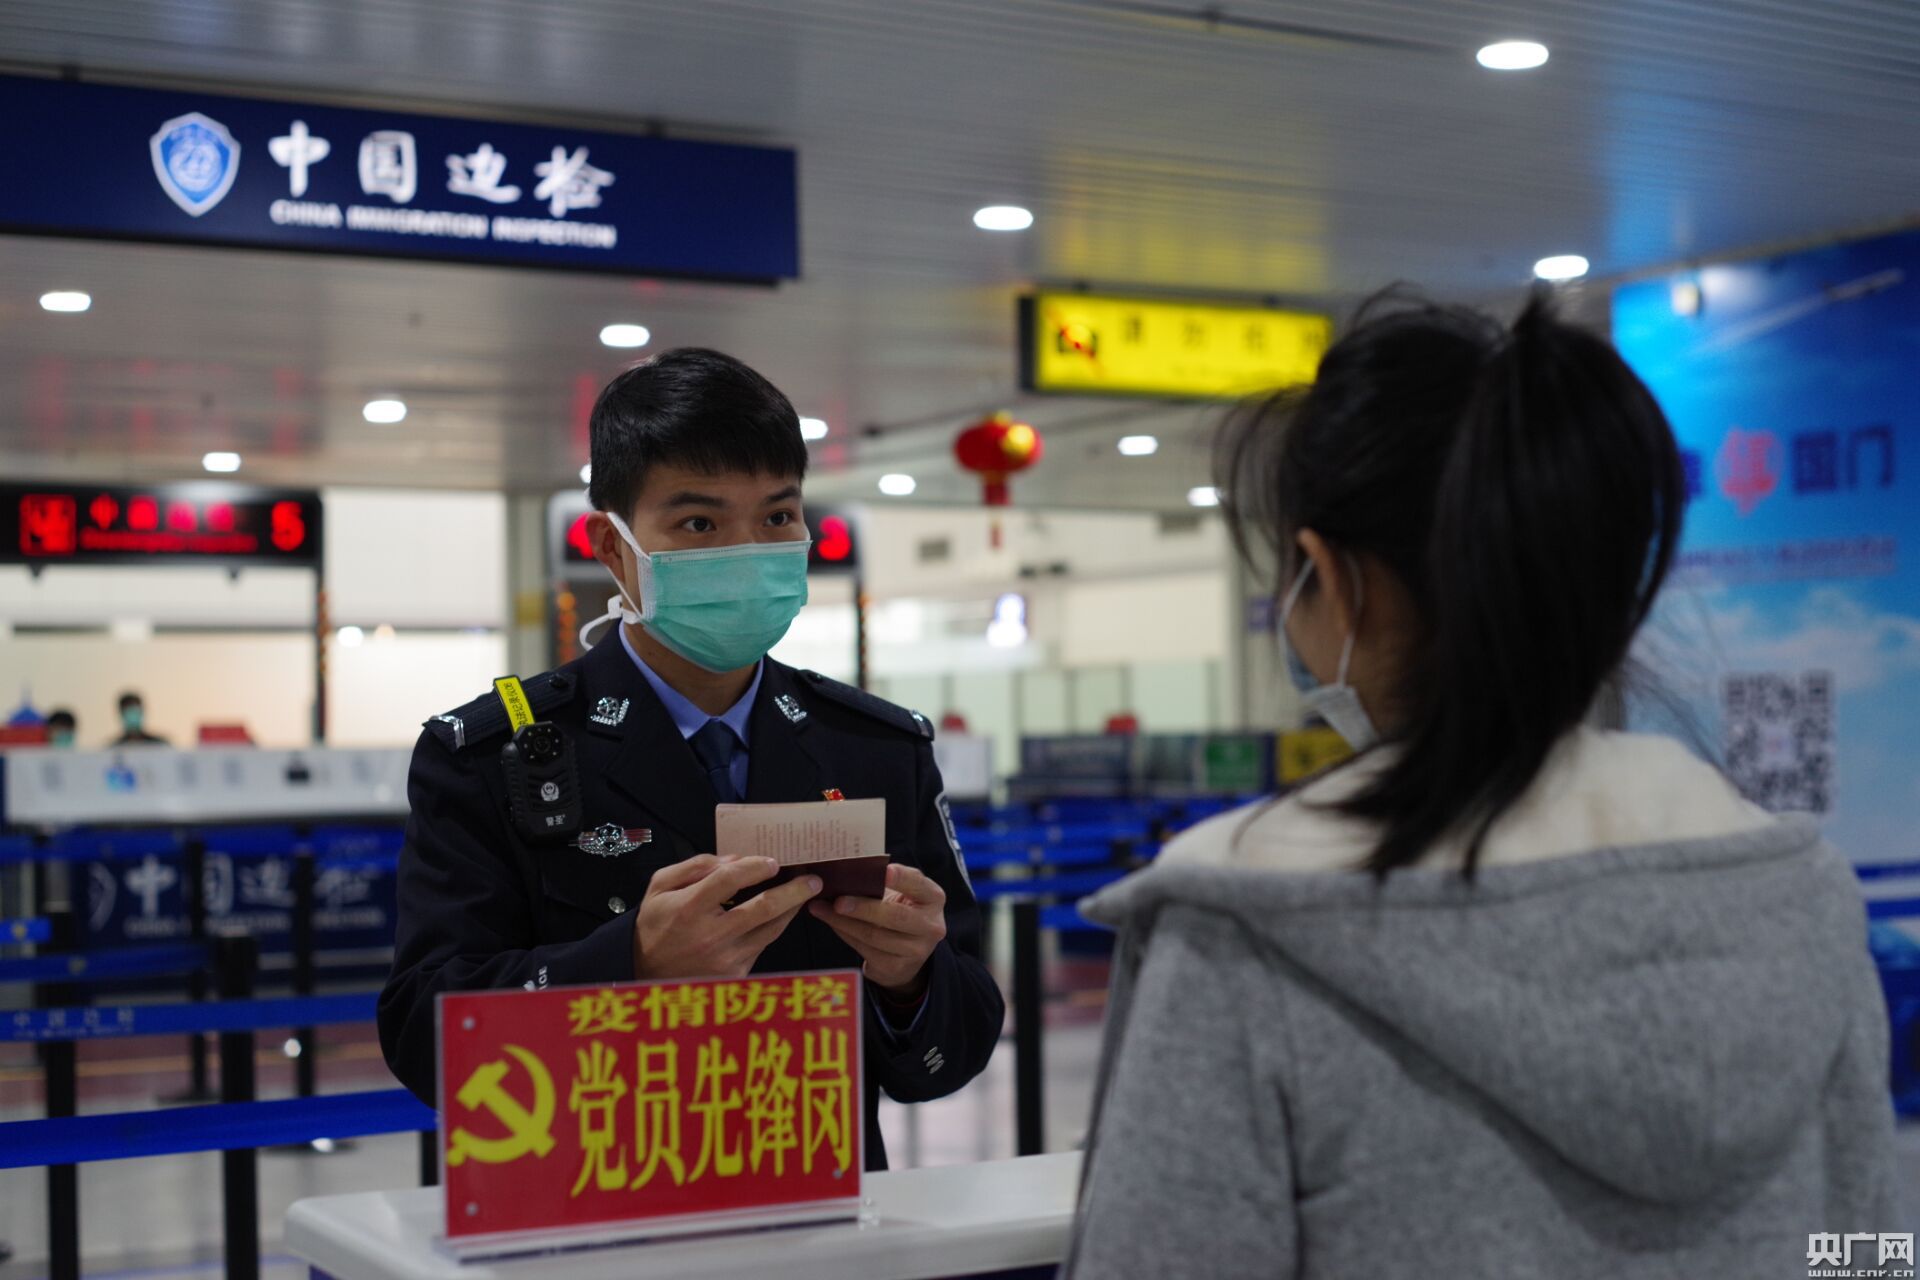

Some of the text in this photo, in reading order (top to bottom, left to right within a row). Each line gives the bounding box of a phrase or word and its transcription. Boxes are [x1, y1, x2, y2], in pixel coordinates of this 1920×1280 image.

[267, 119, 616, 219] 中国边检
[269, 199, 344, 229] CHINA
[568, 976, 850, 1036] 疫情防控
[568, 1027, 851, 1198] 党员先锋岗
